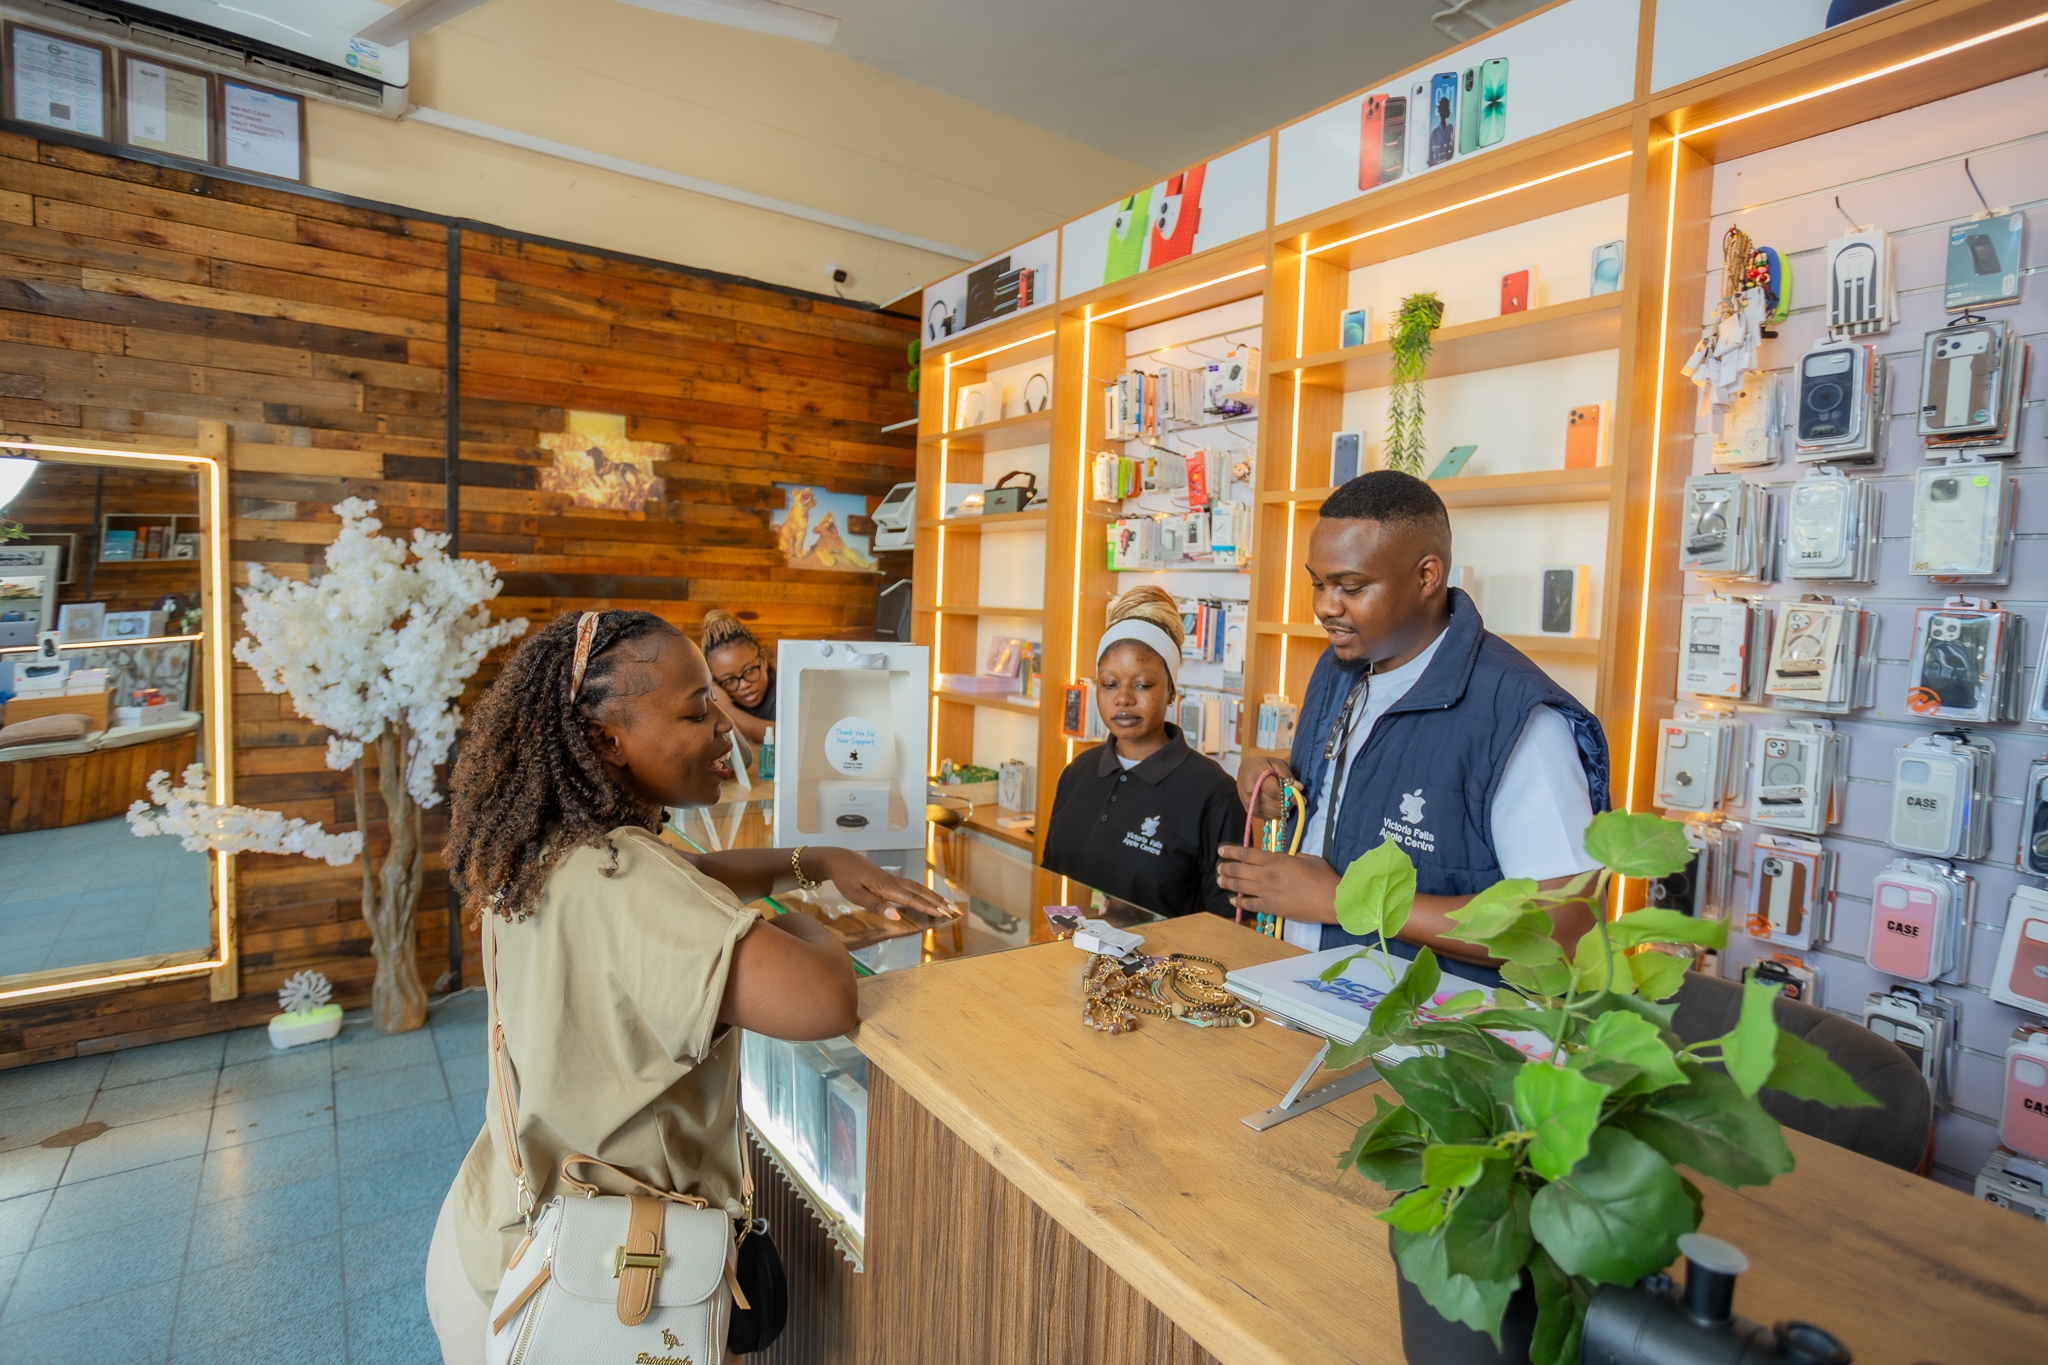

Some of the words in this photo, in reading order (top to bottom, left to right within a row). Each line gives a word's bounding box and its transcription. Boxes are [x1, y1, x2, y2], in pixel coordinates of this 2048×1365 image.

[1813, 428, 1835, 436] CASE
[1801, 551, 1823, 559] CASE
[836, 728, 853, 736] Thank
[850, 738, 875, 746] Support
[1906, 796, 1937, 809] CASE
[1383, 817, 1412, 835] Victoria
[1413, 828, 1435, 842] Falls
[1140, 843, 1161, 855] Centre
[1404, 836, 1435, 852] Centre
[1886, 920, 1919, 937] CASE
[1292, 979, 1378, 1011] APPL
[2023, 1098, 2048, 1117] CAS
